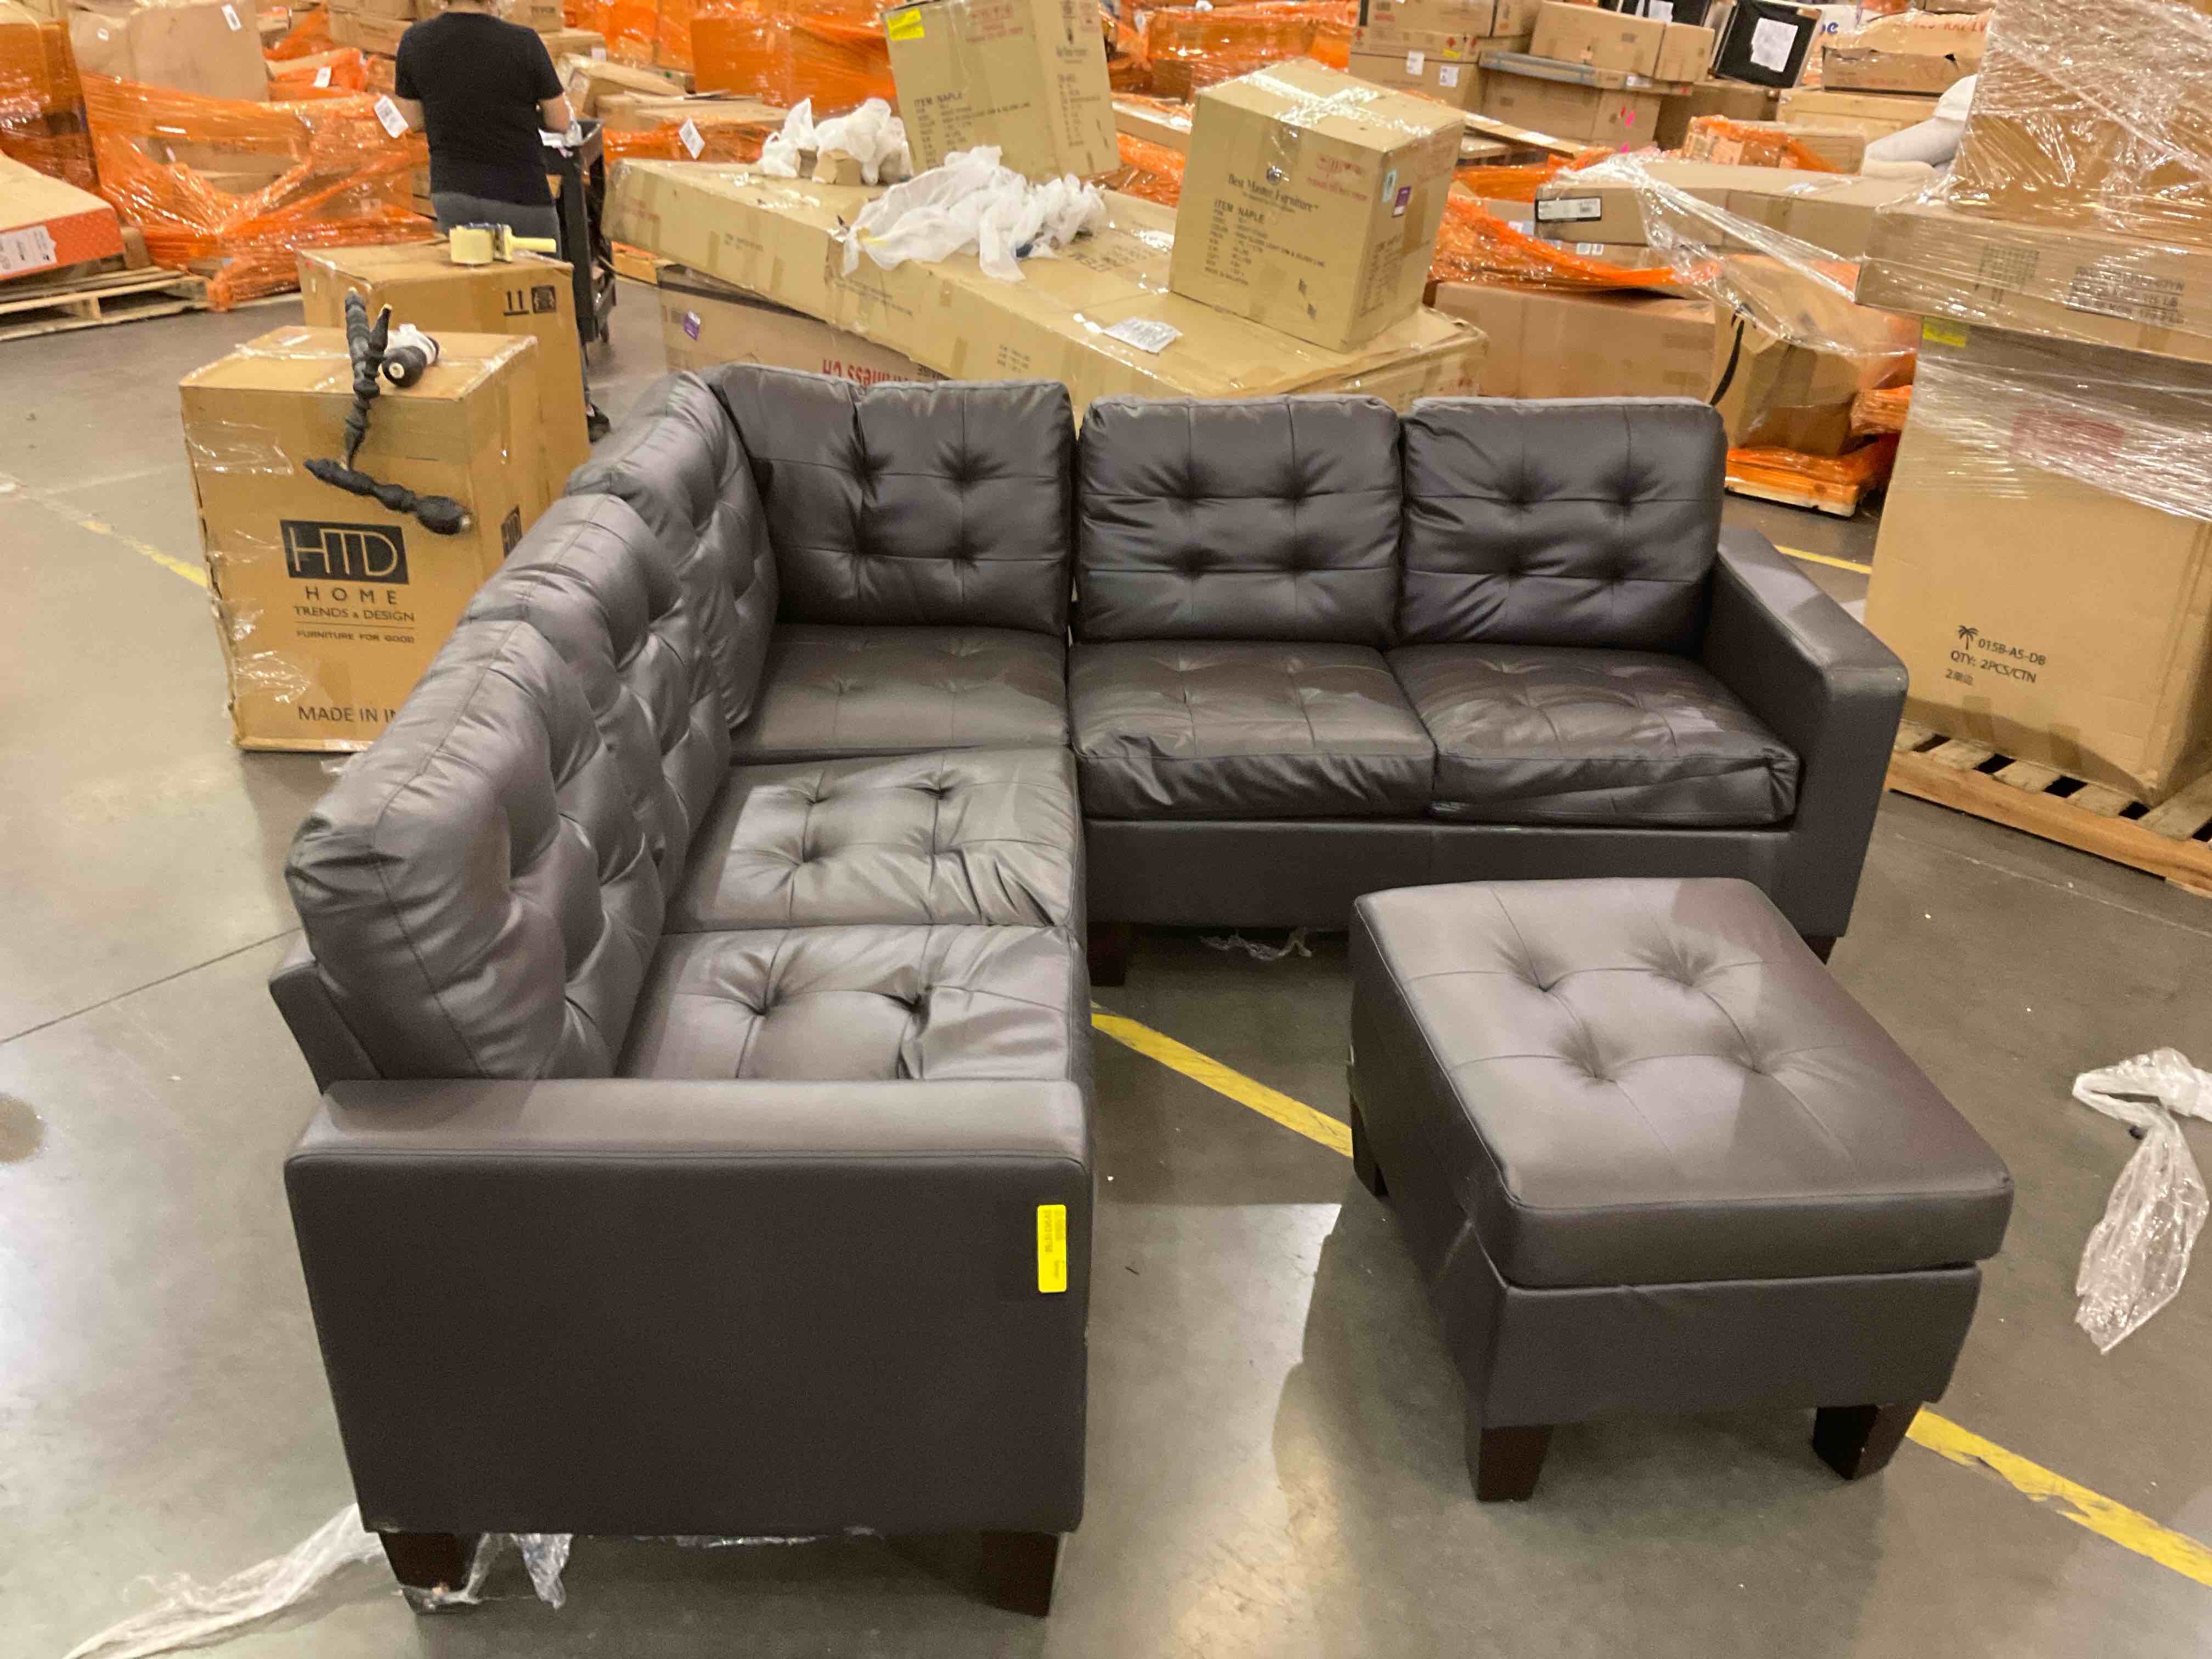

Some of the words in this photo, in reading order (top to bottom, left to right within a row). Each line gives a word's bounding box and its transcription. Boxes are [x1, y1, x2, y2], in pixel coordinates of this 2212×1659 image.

[1215, 200, 1234, 212] ITEM
[1238, 206, 1265, 225] NAPLE
[289, 526, 398, 577] HTD
[305, 585, 398, 605] HOME
[294, 605, 348, 618] TRENDS
[363, 609, 415, 622] DESIGN
[296, 630, 354, 641] FURNITURE
[359, 633, 381, 641] FOR
[384, 635, 415, 644] GOOD
[1950, 650, 1976, 667] QTY:
[1980, 659, 2037, 684] 2PCS/CTN
[298, 706, 355, 722] MADE
[360, 708, 378, 722] IN
